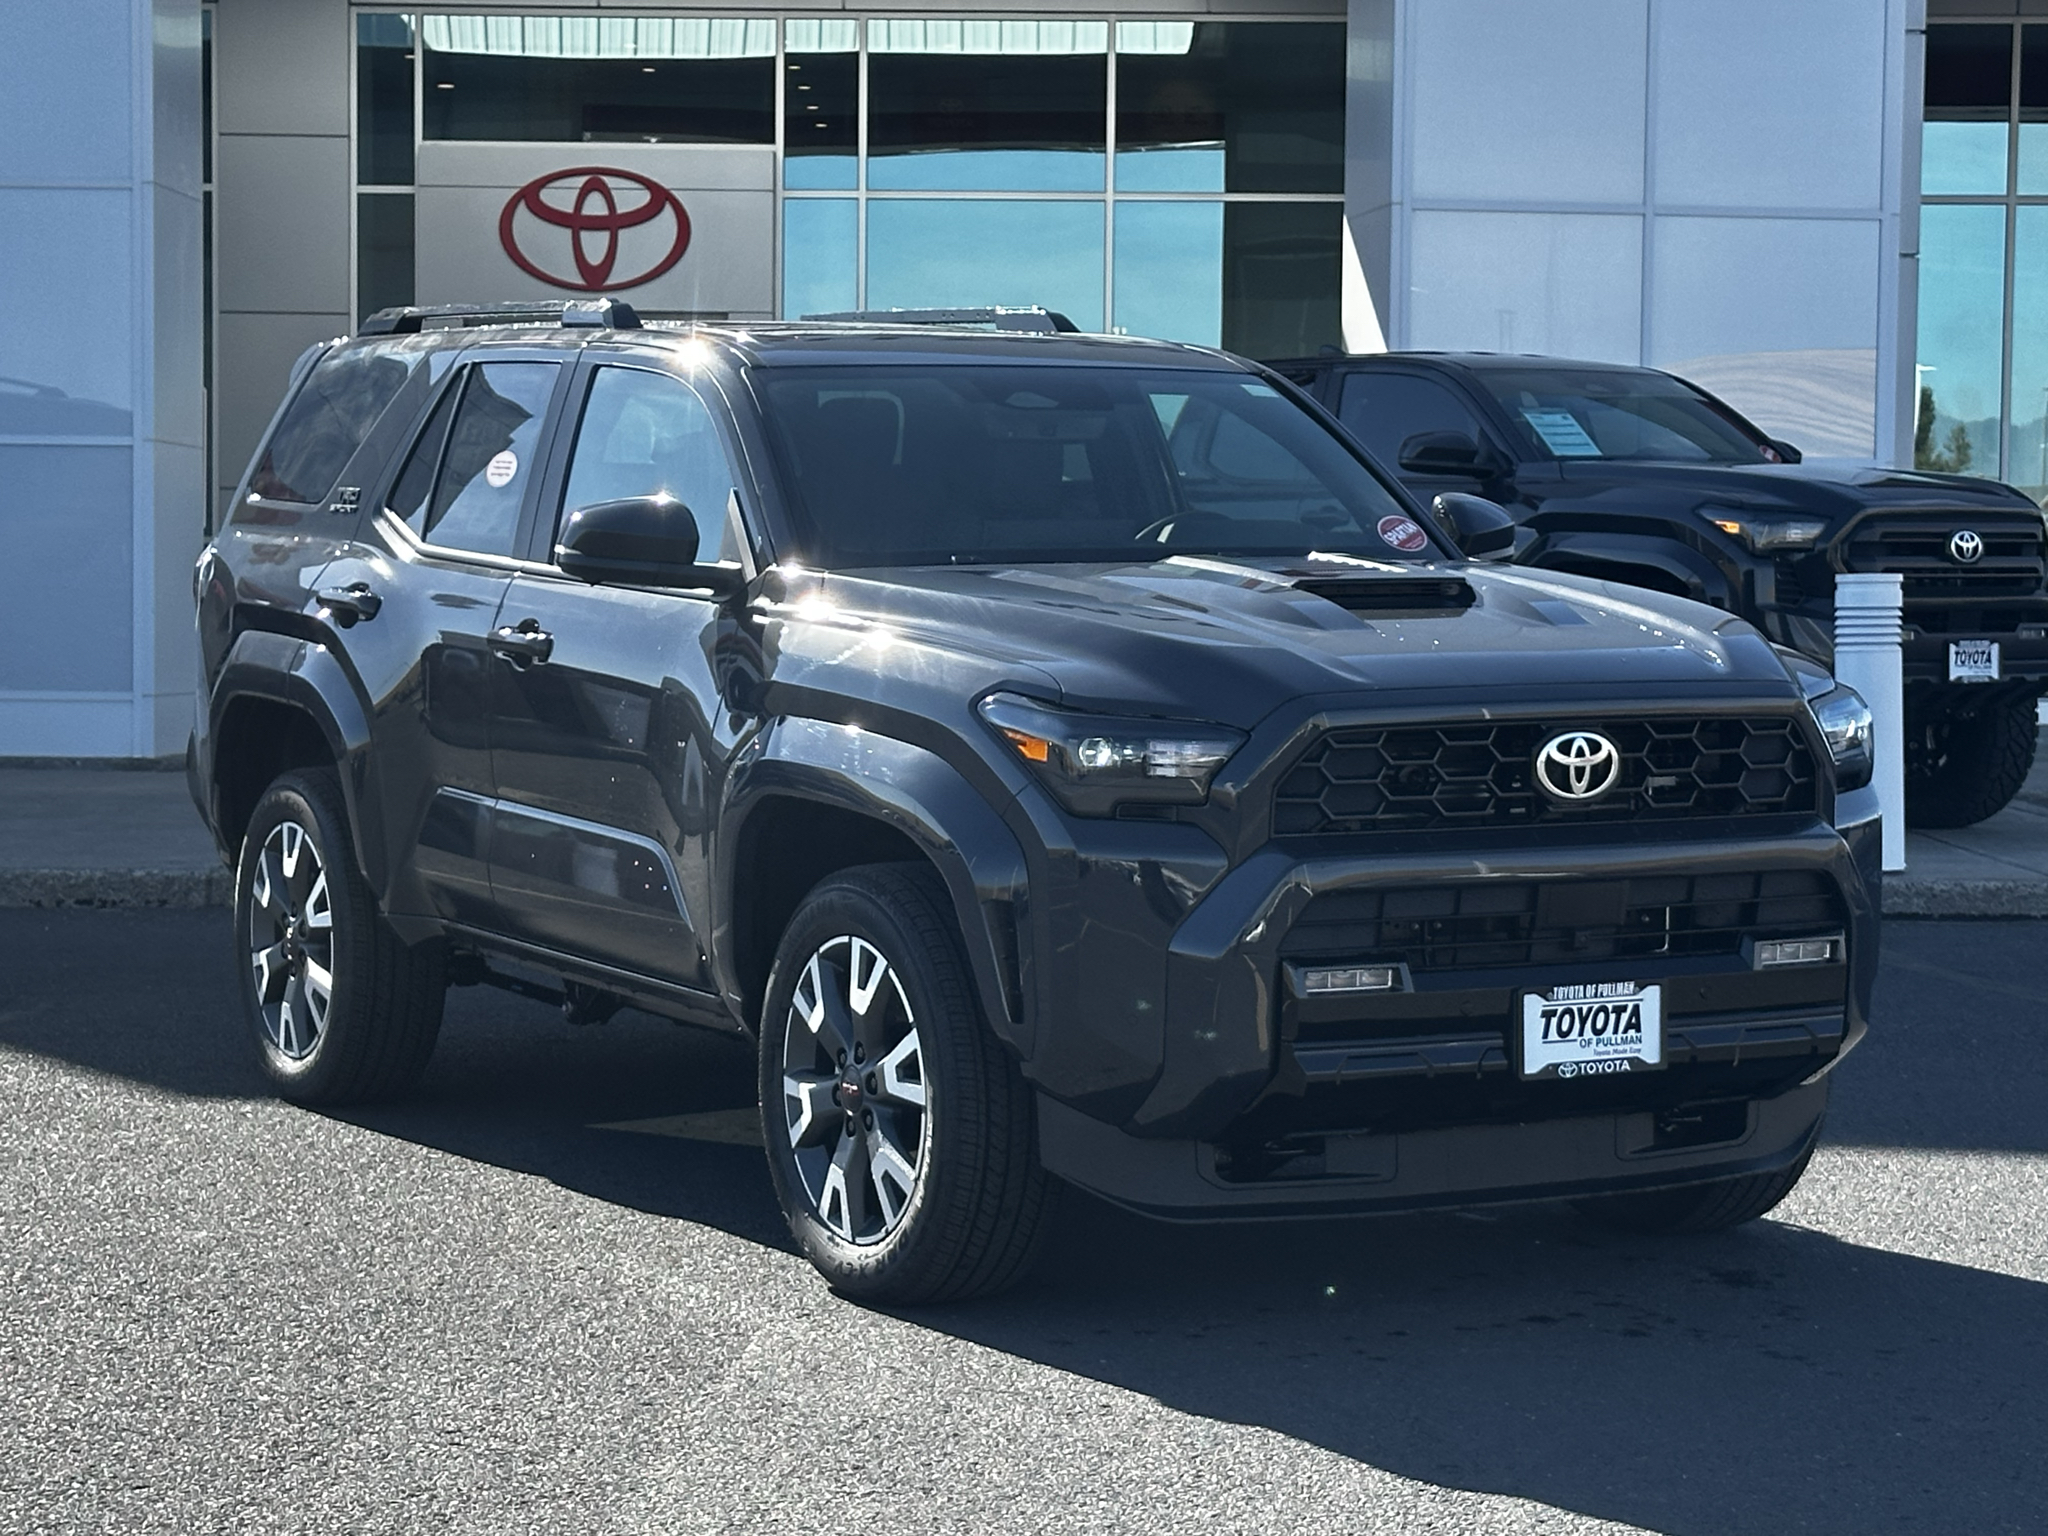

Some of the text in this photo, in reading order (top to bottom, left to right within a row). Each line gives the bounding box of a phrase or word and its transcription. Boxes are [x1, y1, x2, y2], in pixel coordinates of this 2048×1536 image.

[1954, 649, 1992, 665] TOYOTA
[1553, 981, 1635, 1000] TOYOTA OF PULLMAN
[1540, 1003, 1641, 1039] TOYOTA
[1580, 1034, 1642, 1048] OF PULLMAN
[1579, 1060, 1630, 1075] TOYOTA
